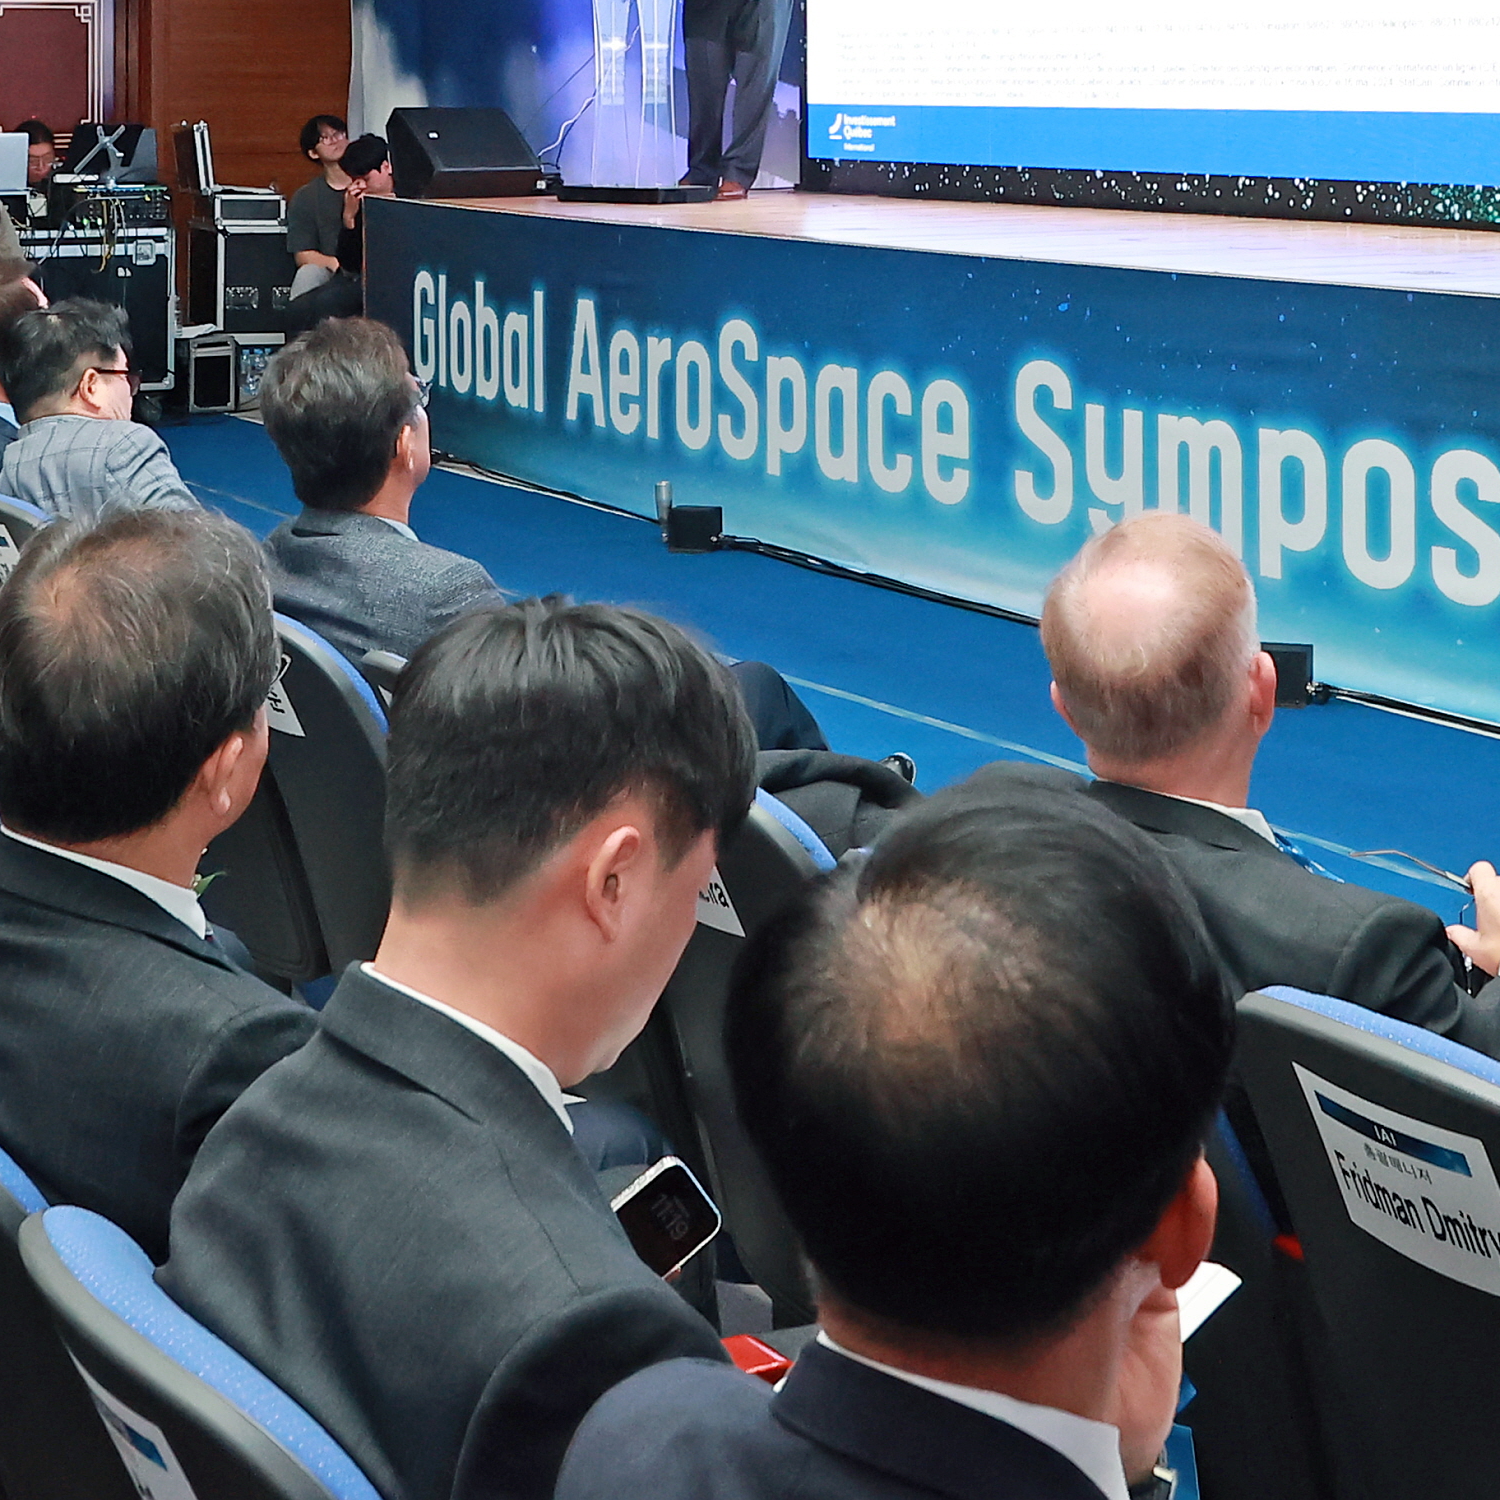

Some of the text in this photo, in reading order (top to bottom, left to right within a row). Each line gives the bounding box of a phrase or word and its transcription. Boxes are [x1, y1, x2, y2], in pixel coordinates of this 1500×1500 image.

[412, 269, 546, 414] Global
[565, 298, 971, 506] AeroSpace
[1373, 1124, 1398, 1147] IAI
[1334, 1149, 1426, 1234] Fridman
